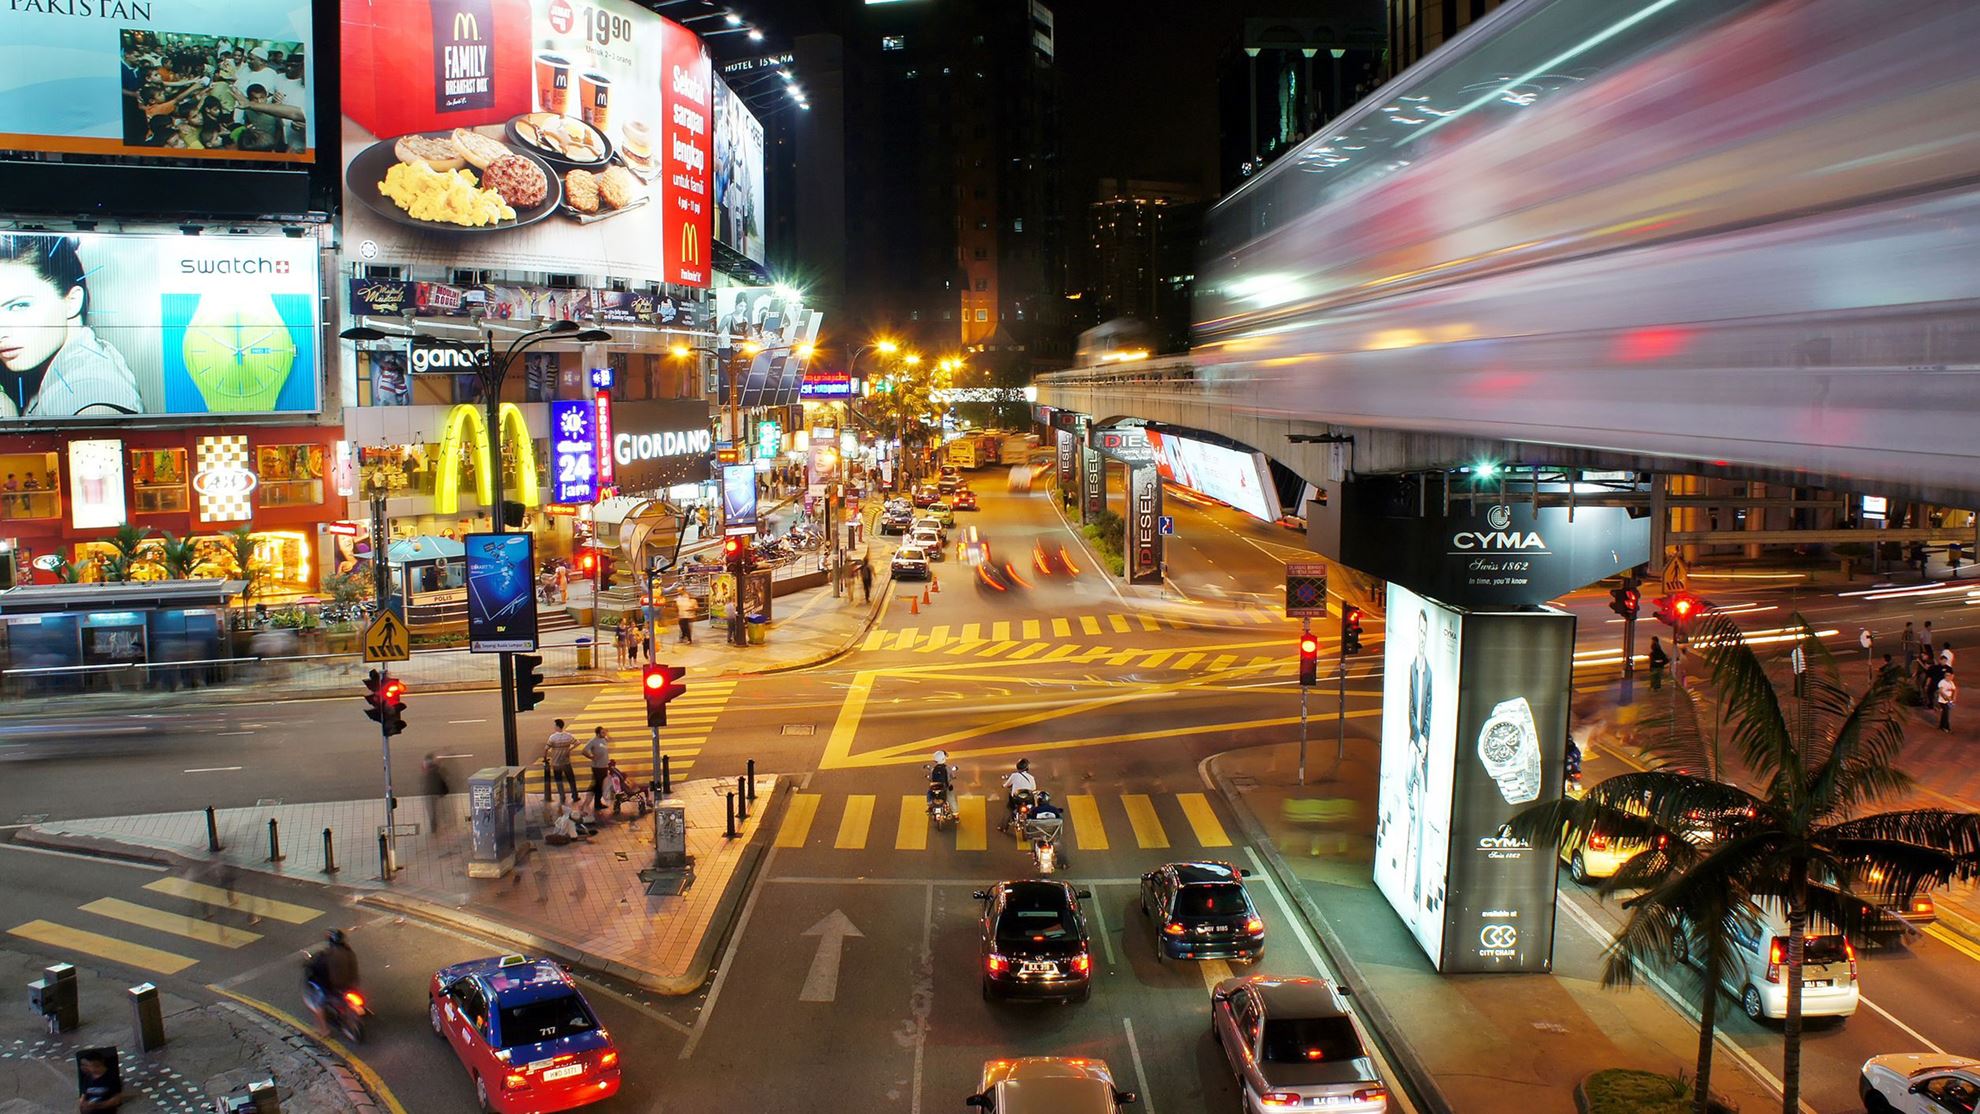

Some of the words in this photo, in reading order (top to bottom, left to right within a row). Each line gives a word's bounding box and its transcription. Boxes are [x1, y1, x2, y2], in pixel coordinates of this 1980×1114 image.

[444, 45, 487, 79] FAMILY
[725, 60, 753, 72] HOTEL
[673, 132, 704, 176] lengkap
[673, 174, 690, 190] untuk
[181, 256, 273, 274] swatch
[614, 429, 710, 465] GIORDANO
[559, 454, 592, 482] 24
[560, 483, 590, 500] jam
[1140, 484, 1154, 565] DIESEL
[1453, 532, 1546, 549] CYMA
[1468, 558, 1499, 571] Swiss
[1502, 561, 1529, 571] 1862
[1480, 837, 1529, 848] CYMA
[539, 1026, 556, 1036] 717
